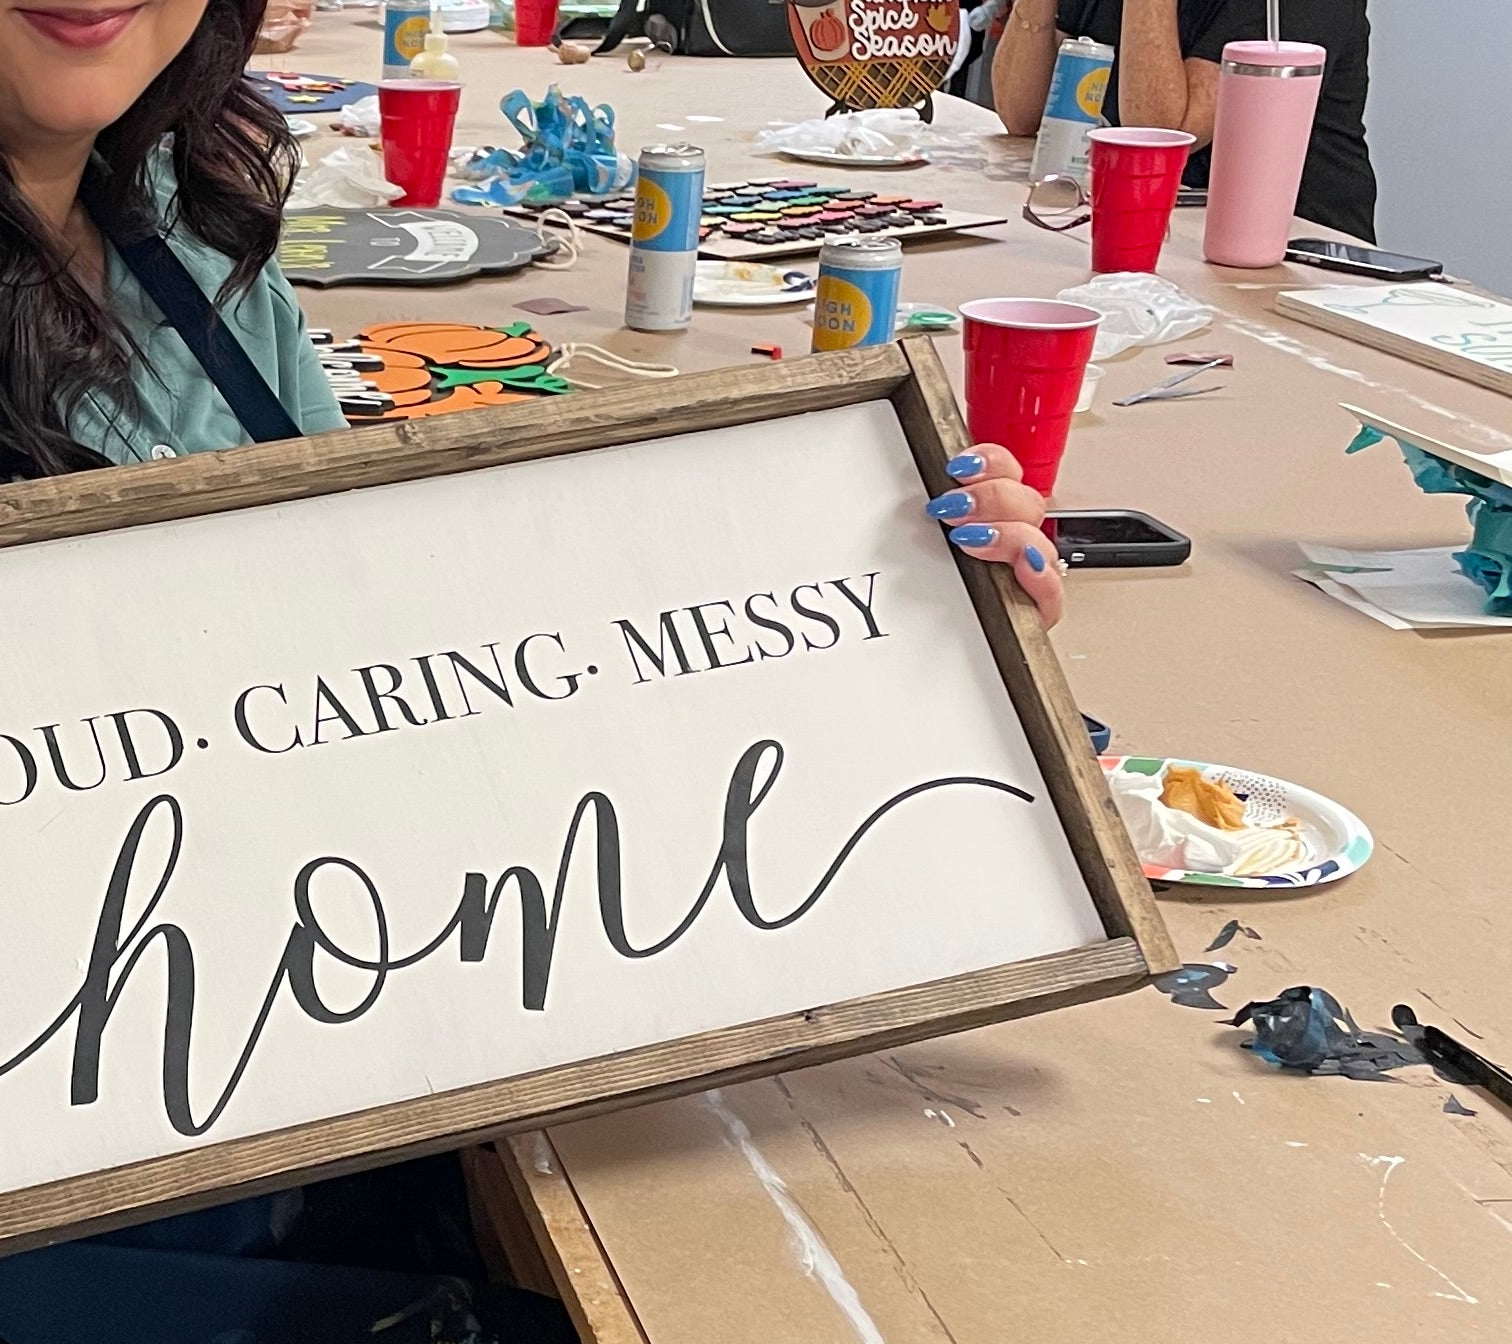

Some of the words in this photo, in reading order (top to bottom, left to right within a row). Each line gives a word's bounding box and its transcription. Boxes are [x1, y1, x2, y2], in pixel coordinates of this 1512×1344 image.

[848, 0, 919, 34] Spice
[851, 28, 958, 61] Season
[612, 571, 891, 689] MESSY
